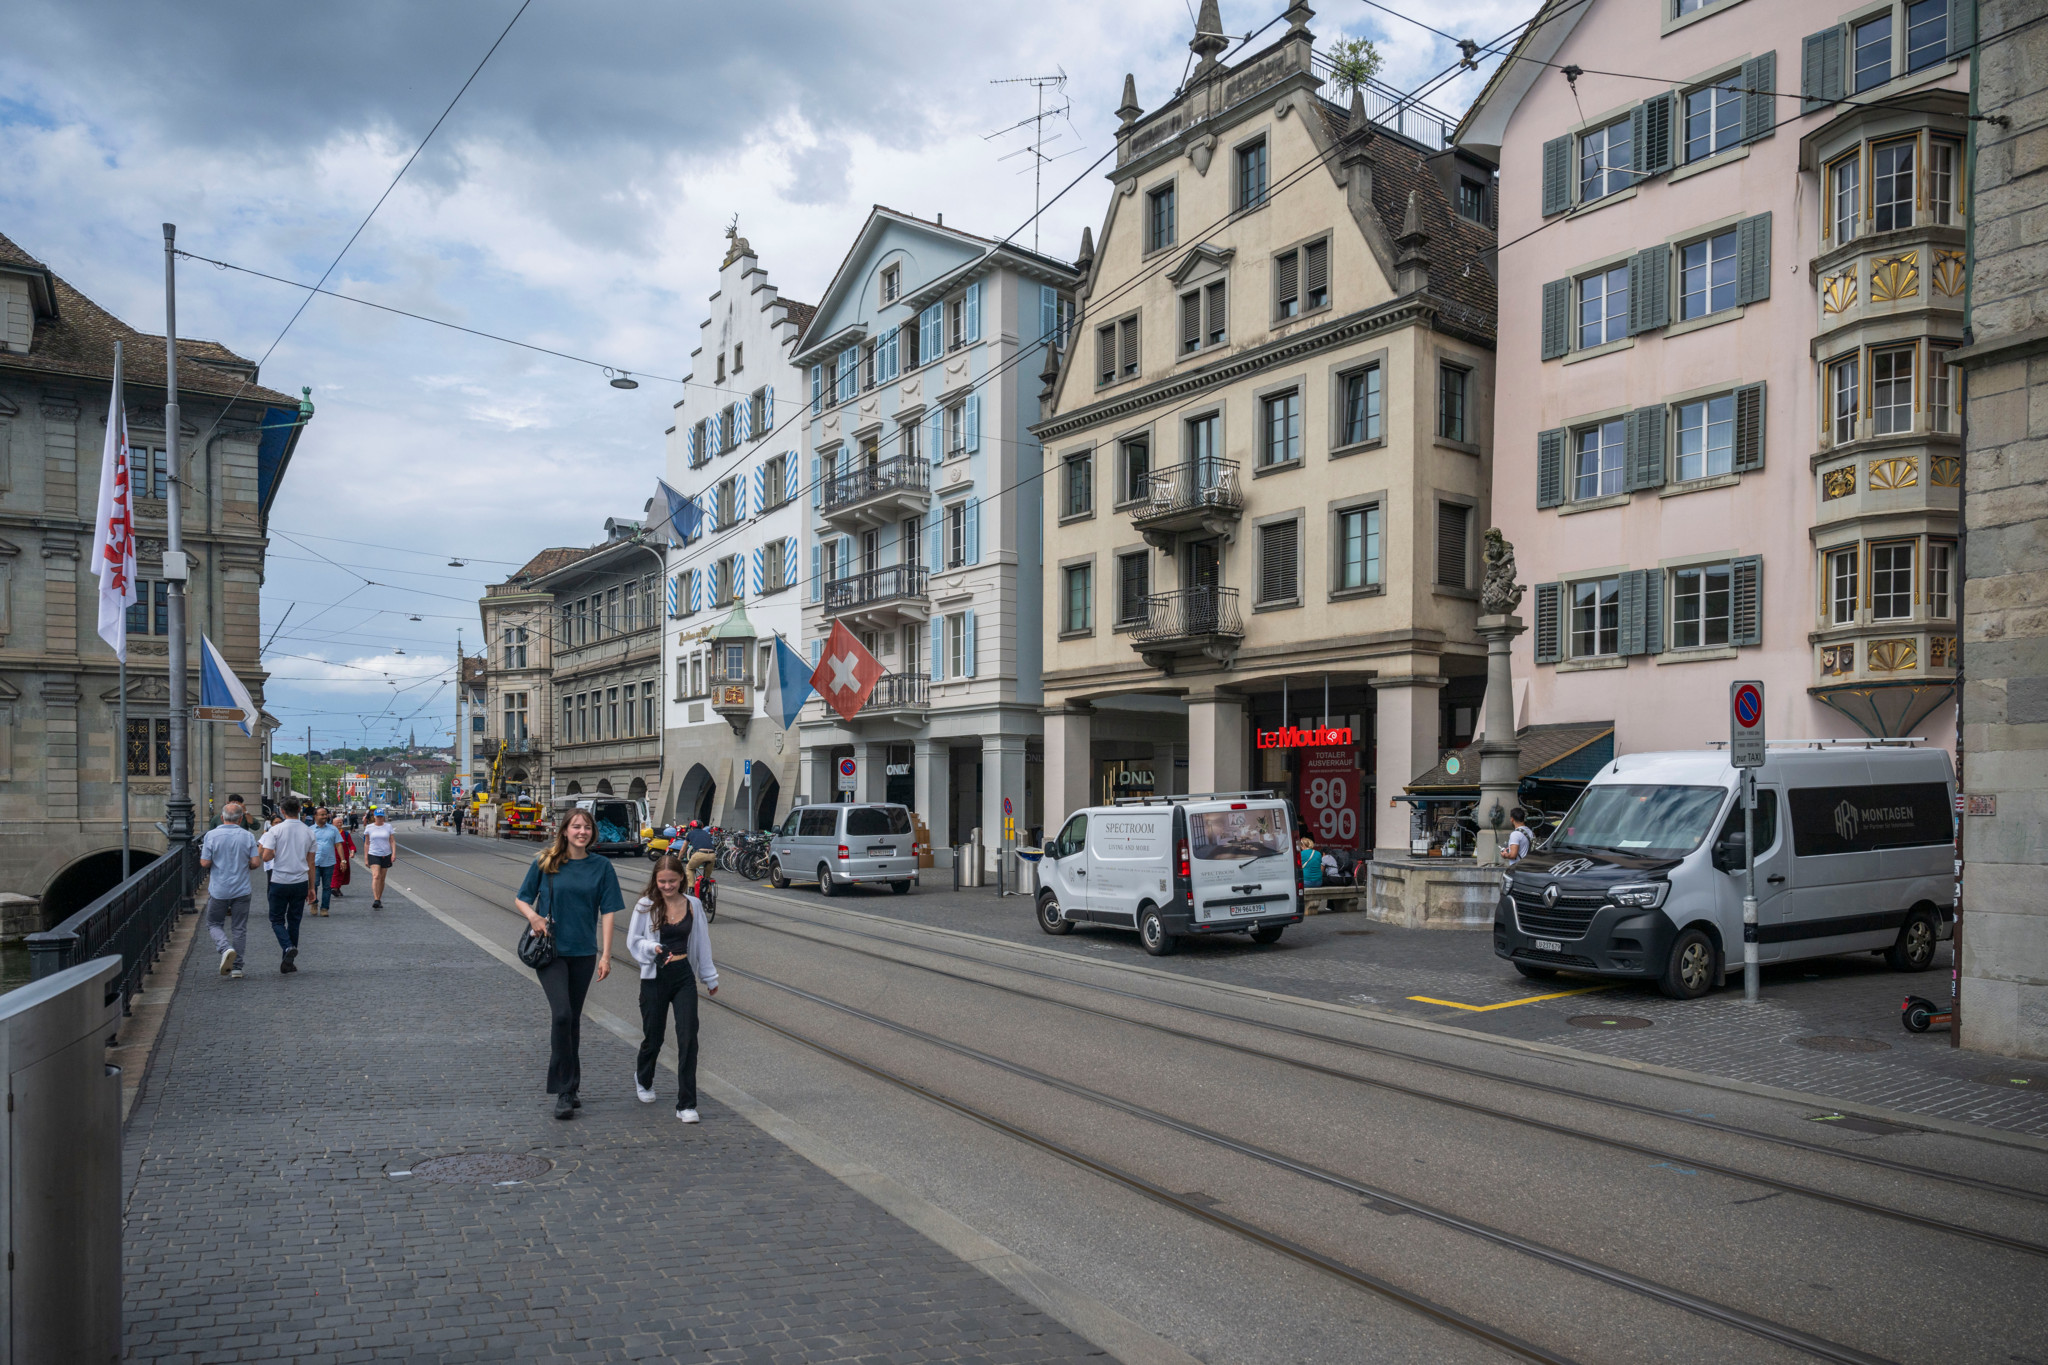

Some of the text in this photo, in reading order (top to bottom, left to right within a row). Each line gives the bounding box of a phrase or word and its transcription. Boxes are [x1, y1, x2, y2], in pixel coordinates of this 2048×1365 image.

[1025, 753, 1045, 762] ONL
[1315, 751, 1346, 759] TOTALER
[1747, 752, 1762, 762] TAXI
[1308, 759, 1353, 767] AUSVERKAUF
[886, 763, 911, 776] ONLY
[1861, 806, 1914, 822] MONTAGEN
[1105, 822, 1155, 834] SPECTROOM
[1135, 844, 1150, 852] MORE
